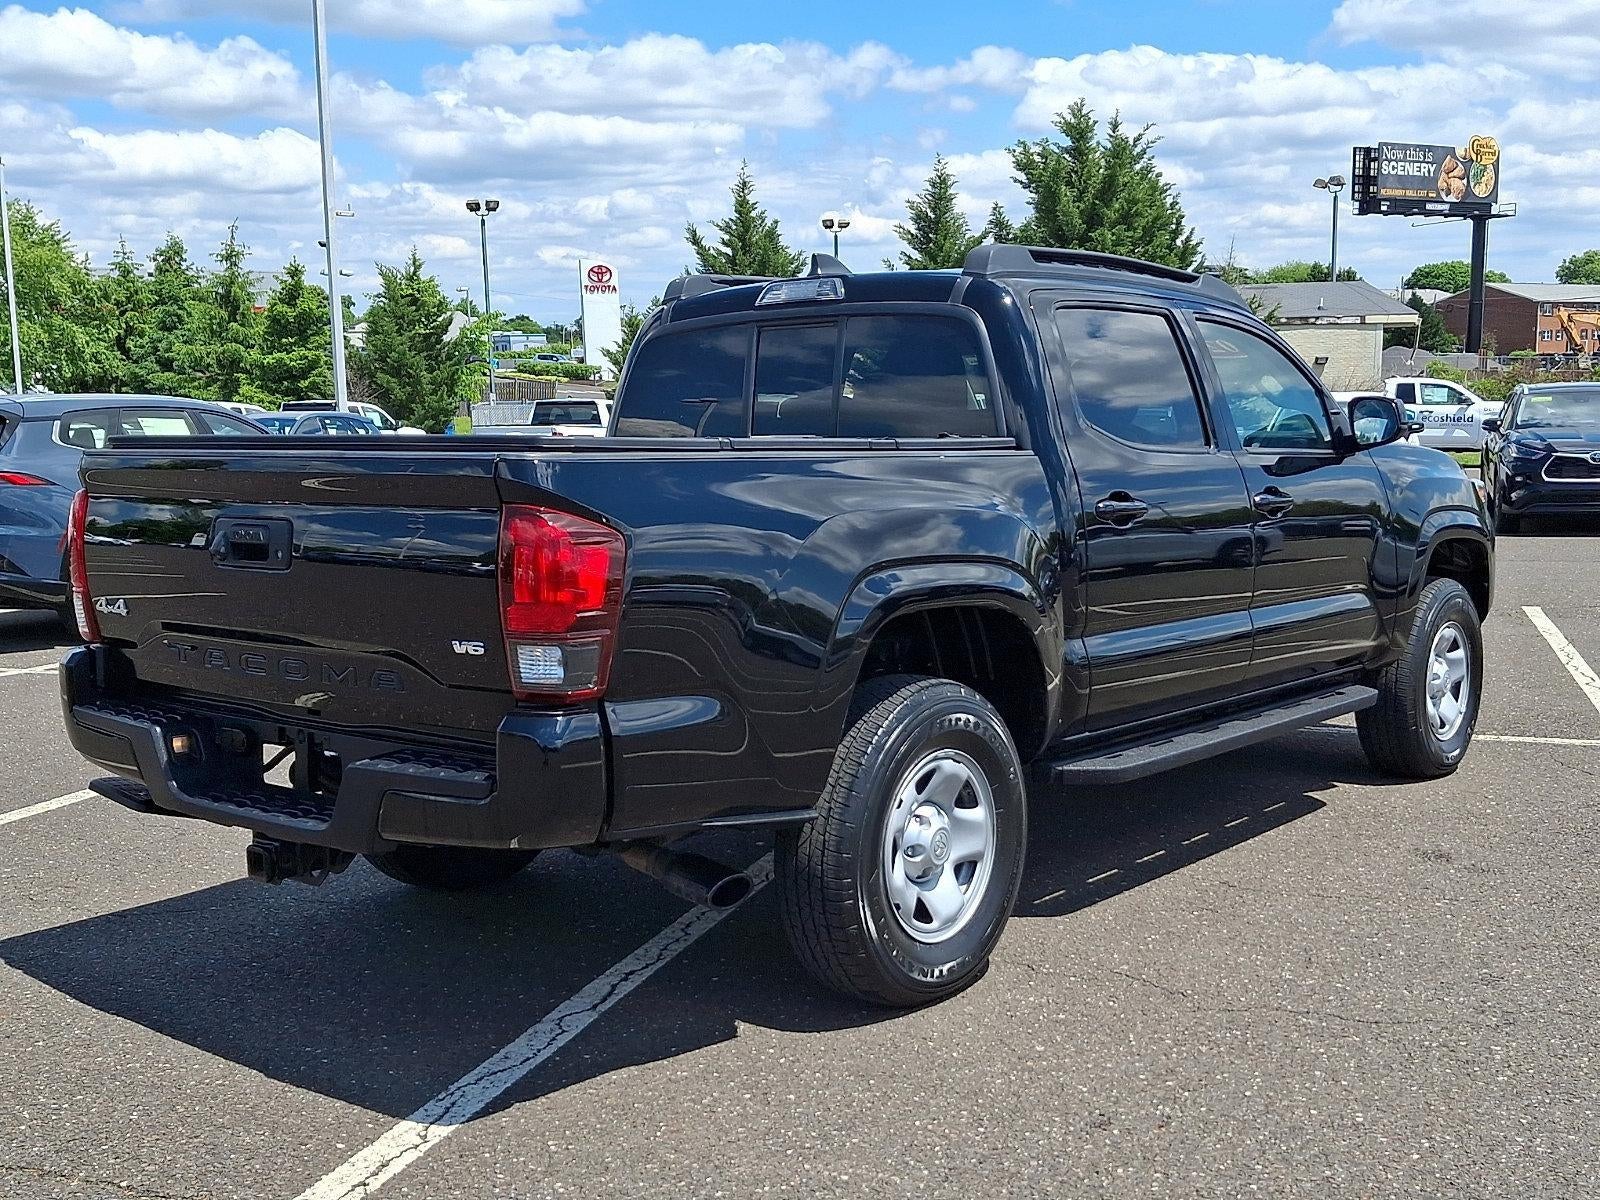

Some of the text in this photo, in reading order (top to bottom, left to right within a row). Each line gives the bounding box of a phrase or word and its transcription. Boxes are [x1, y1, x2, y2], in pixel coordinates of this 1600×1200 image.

[1382, 146, 1433, 162] Now this is
[1472, 139, 1495, 155] Cracker
[1476, 149, 1496, 164] Barrel
[1381, 161, 1437, 177] SCENERY
[584, 285, 617, 294] TOYOTA
[1421, 414, 1474, 423] ecoshield
[96, 597, 127, 616] 4x4
[451, 640, 485, 655] V6
[163, 639, 405, 694] TACOMA
